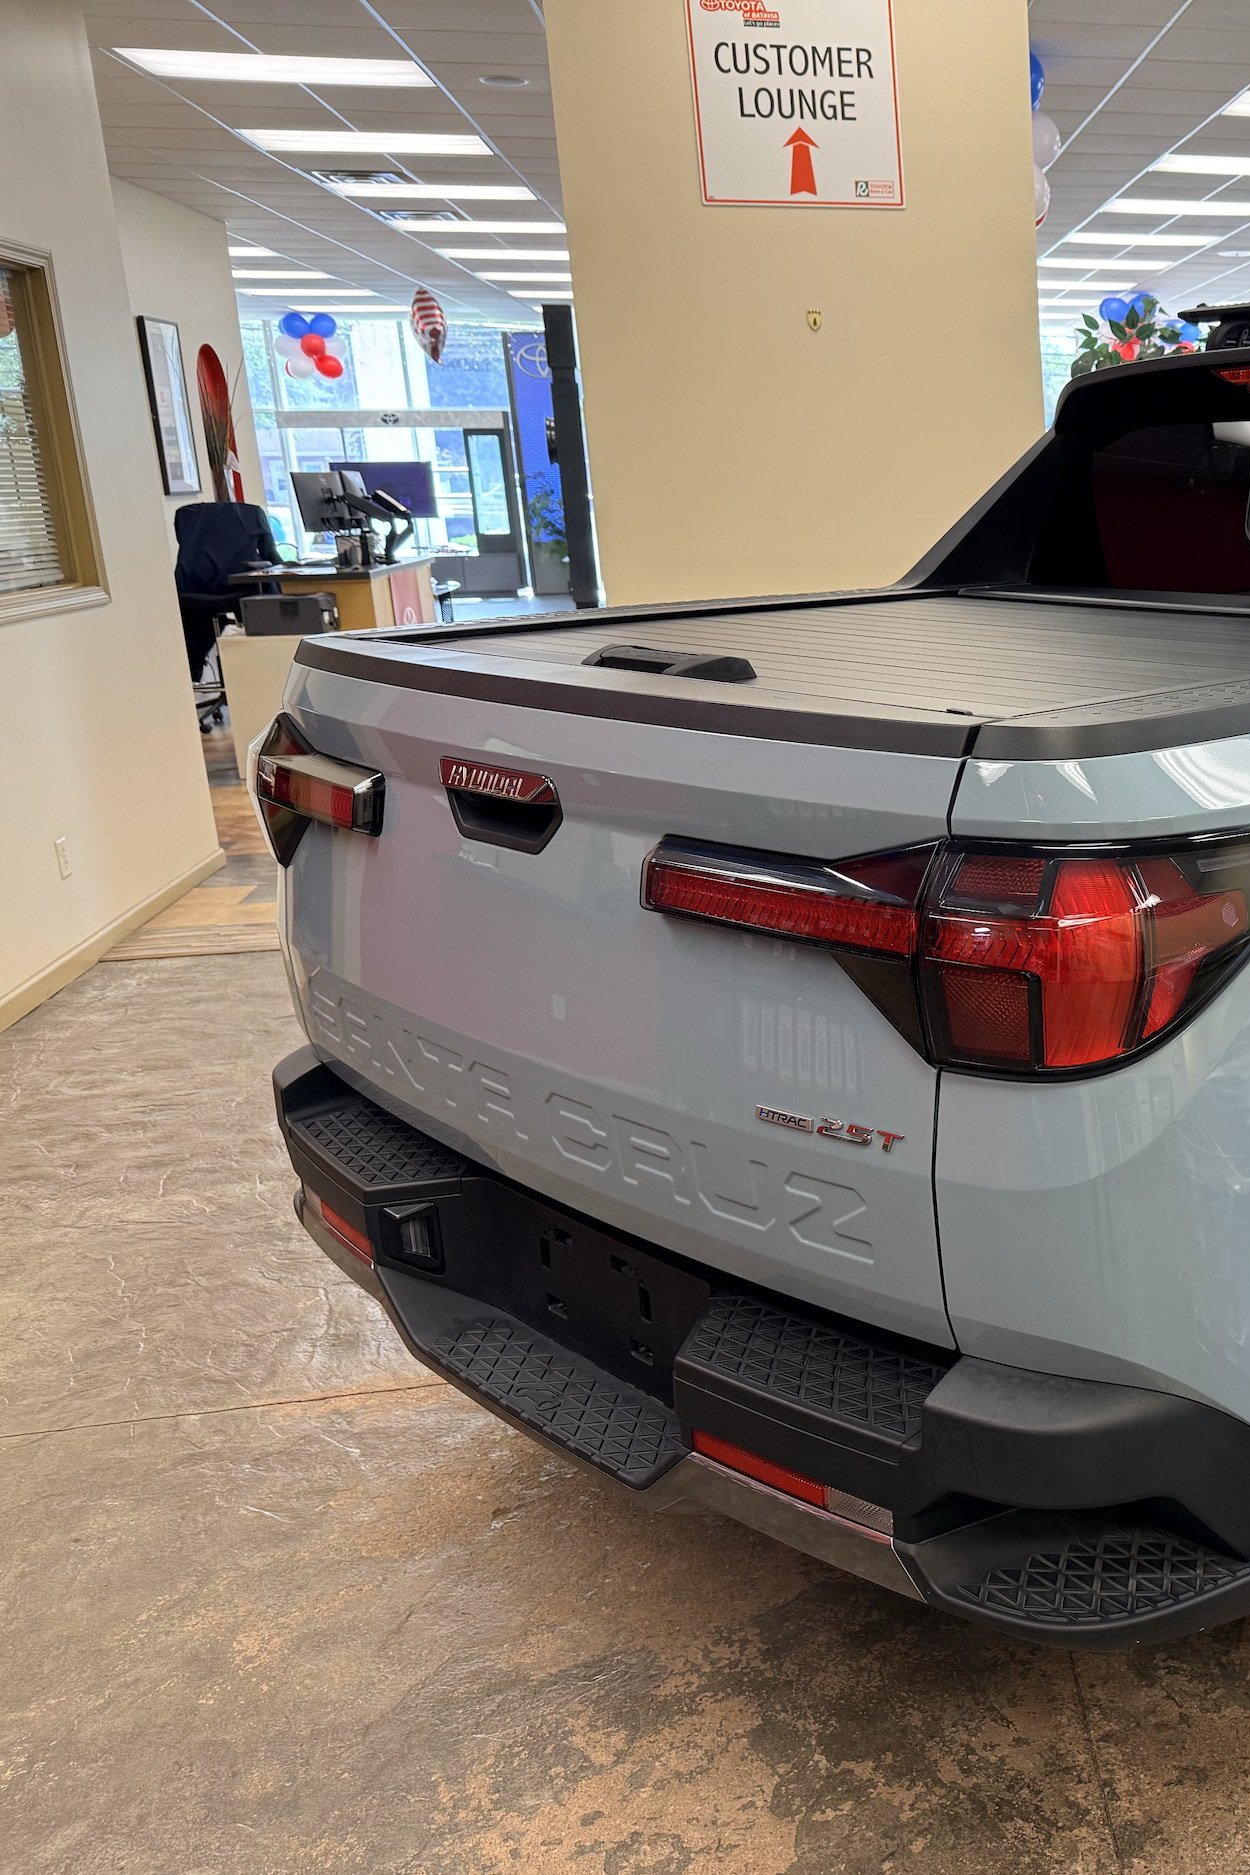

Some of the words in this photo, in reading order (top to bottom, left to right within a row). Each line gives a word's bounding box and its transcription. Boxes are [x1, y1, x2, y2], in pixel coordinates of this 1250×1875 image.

[719, 0, 765, 11] TOYOTA
[714, 42, 874, 79] CUSTOMER
[738, 87, 857, 121] LOUNGE
[759, 1107, 807, 1128] HTRAC
[545, 1091, 875, 1266] CRUZ
